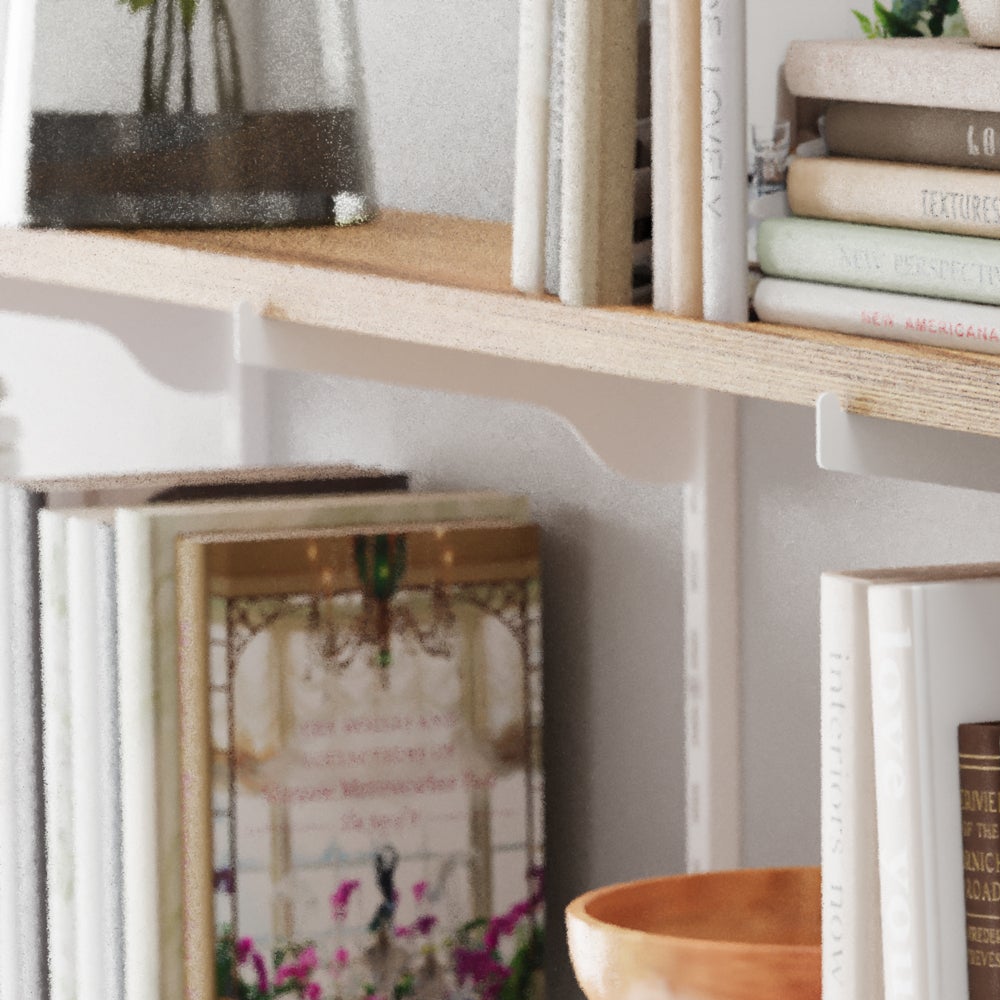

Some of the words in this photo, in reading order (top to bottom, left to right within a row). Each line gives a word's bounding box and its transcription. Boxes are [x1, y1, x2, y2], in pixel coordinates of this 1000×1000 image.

[920, 188, 1000, 224] TEXTURES
[904, 317, 1000, 342] AMERICANA
[878, 626, 913, 799] love
[829, 651, 850, 855] interiors
[976, 822, 1000, 841] THE
[829, 883, 844, 984] now
